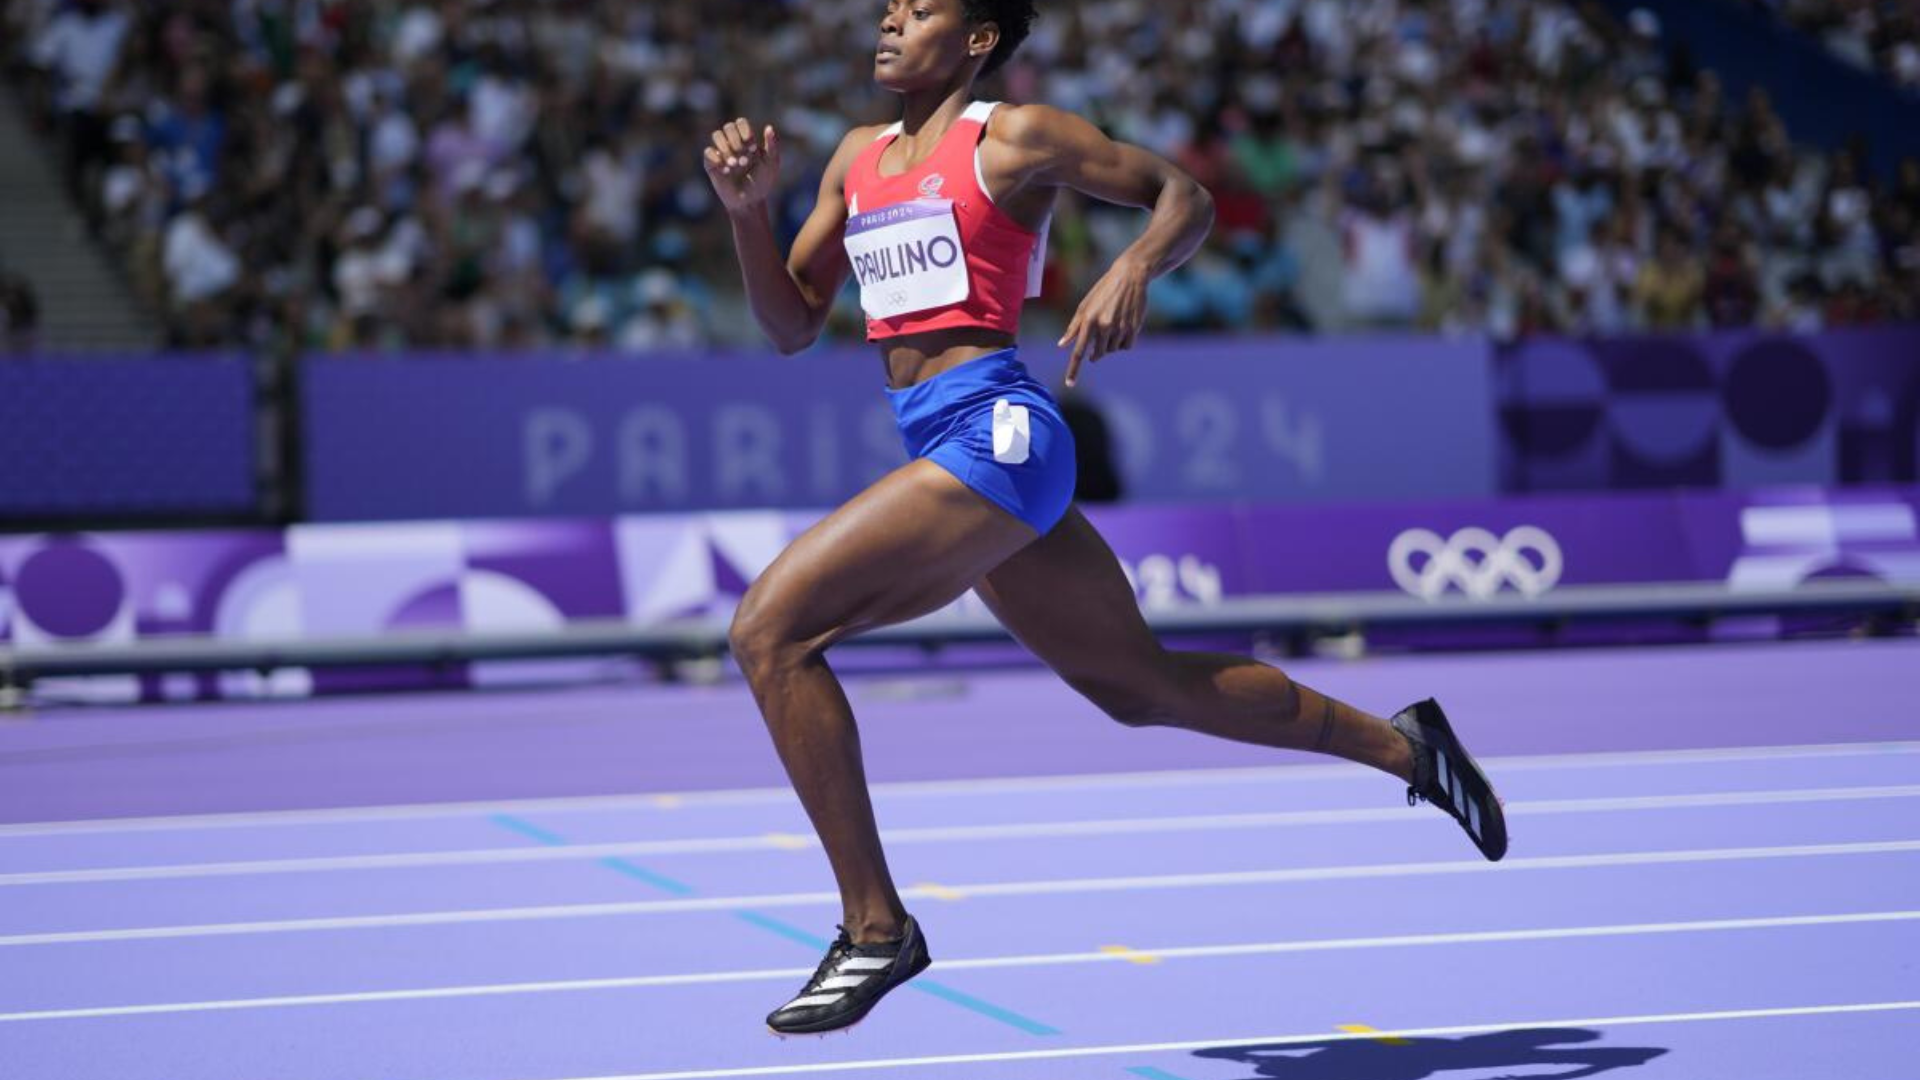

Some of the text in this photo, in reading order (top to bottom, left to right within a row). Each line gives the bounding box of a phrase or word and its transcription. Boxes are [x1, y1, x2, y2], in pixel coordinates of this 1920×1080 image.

[860, 206, 914, 227] PARIS 2024
[854, 235, 958, 286] PAULINO
